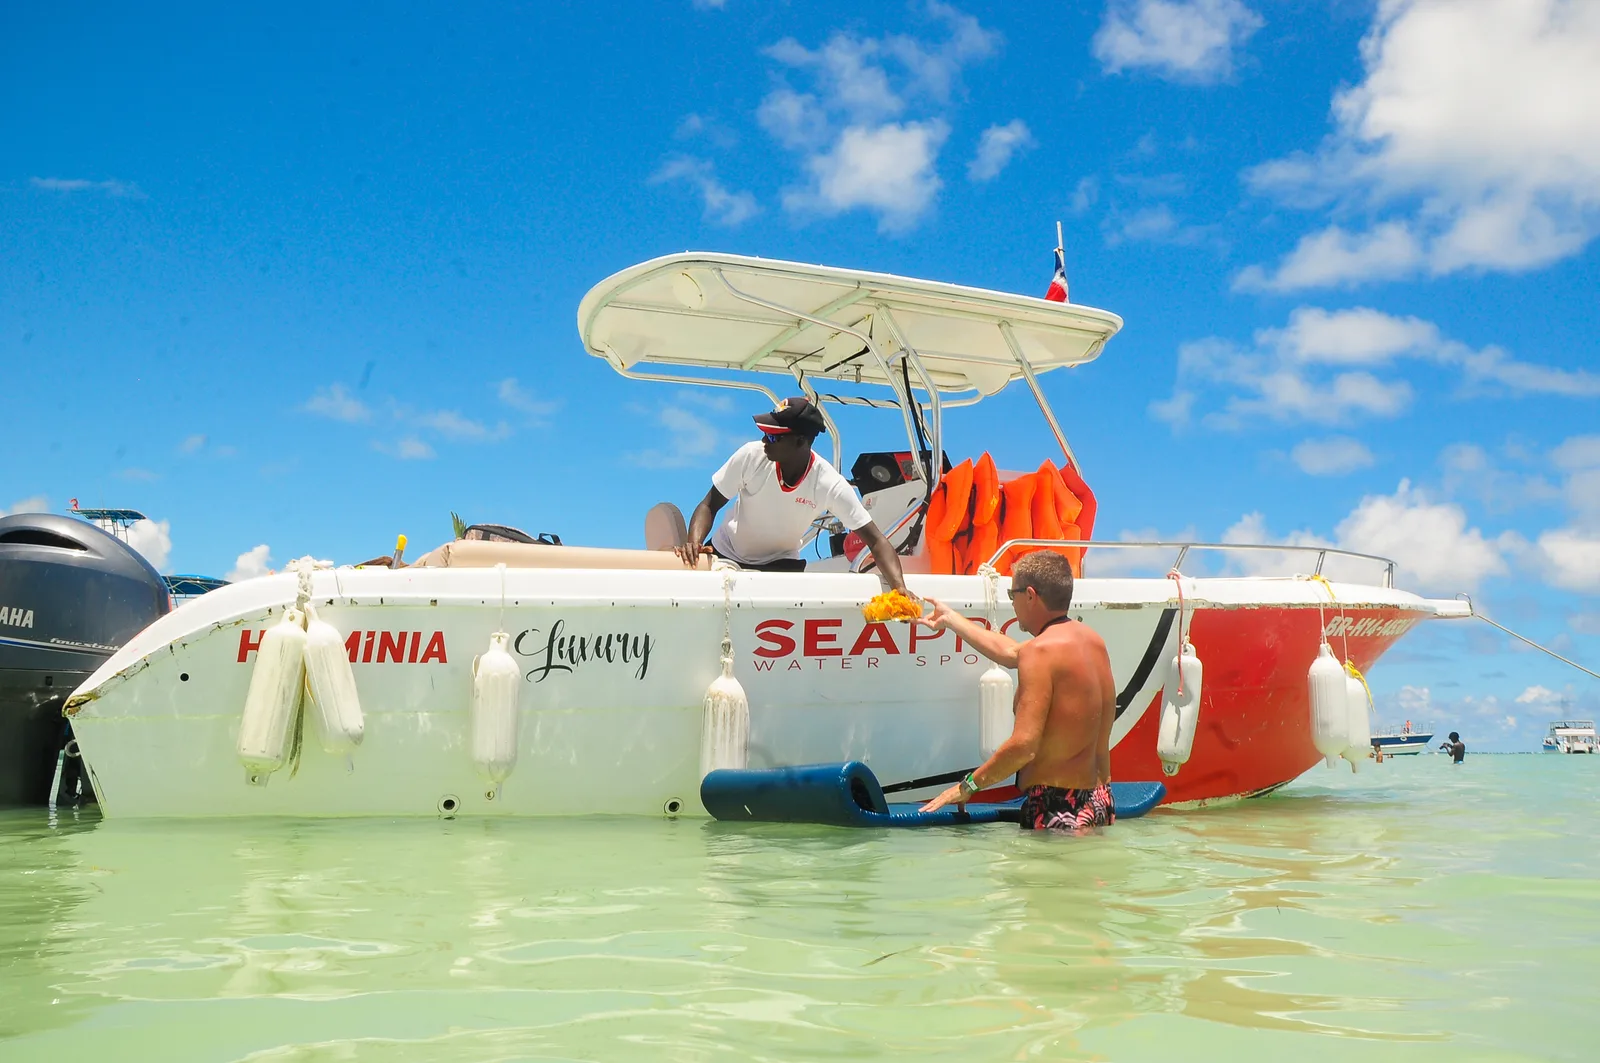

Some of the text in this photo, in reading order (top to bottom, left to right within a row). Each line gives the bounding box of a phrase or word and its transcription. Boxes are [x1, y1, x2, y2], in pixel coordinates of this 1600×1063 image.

[514, 619, 655, 683] Luxury
[753, 653, 979, 672] WATER SPO
